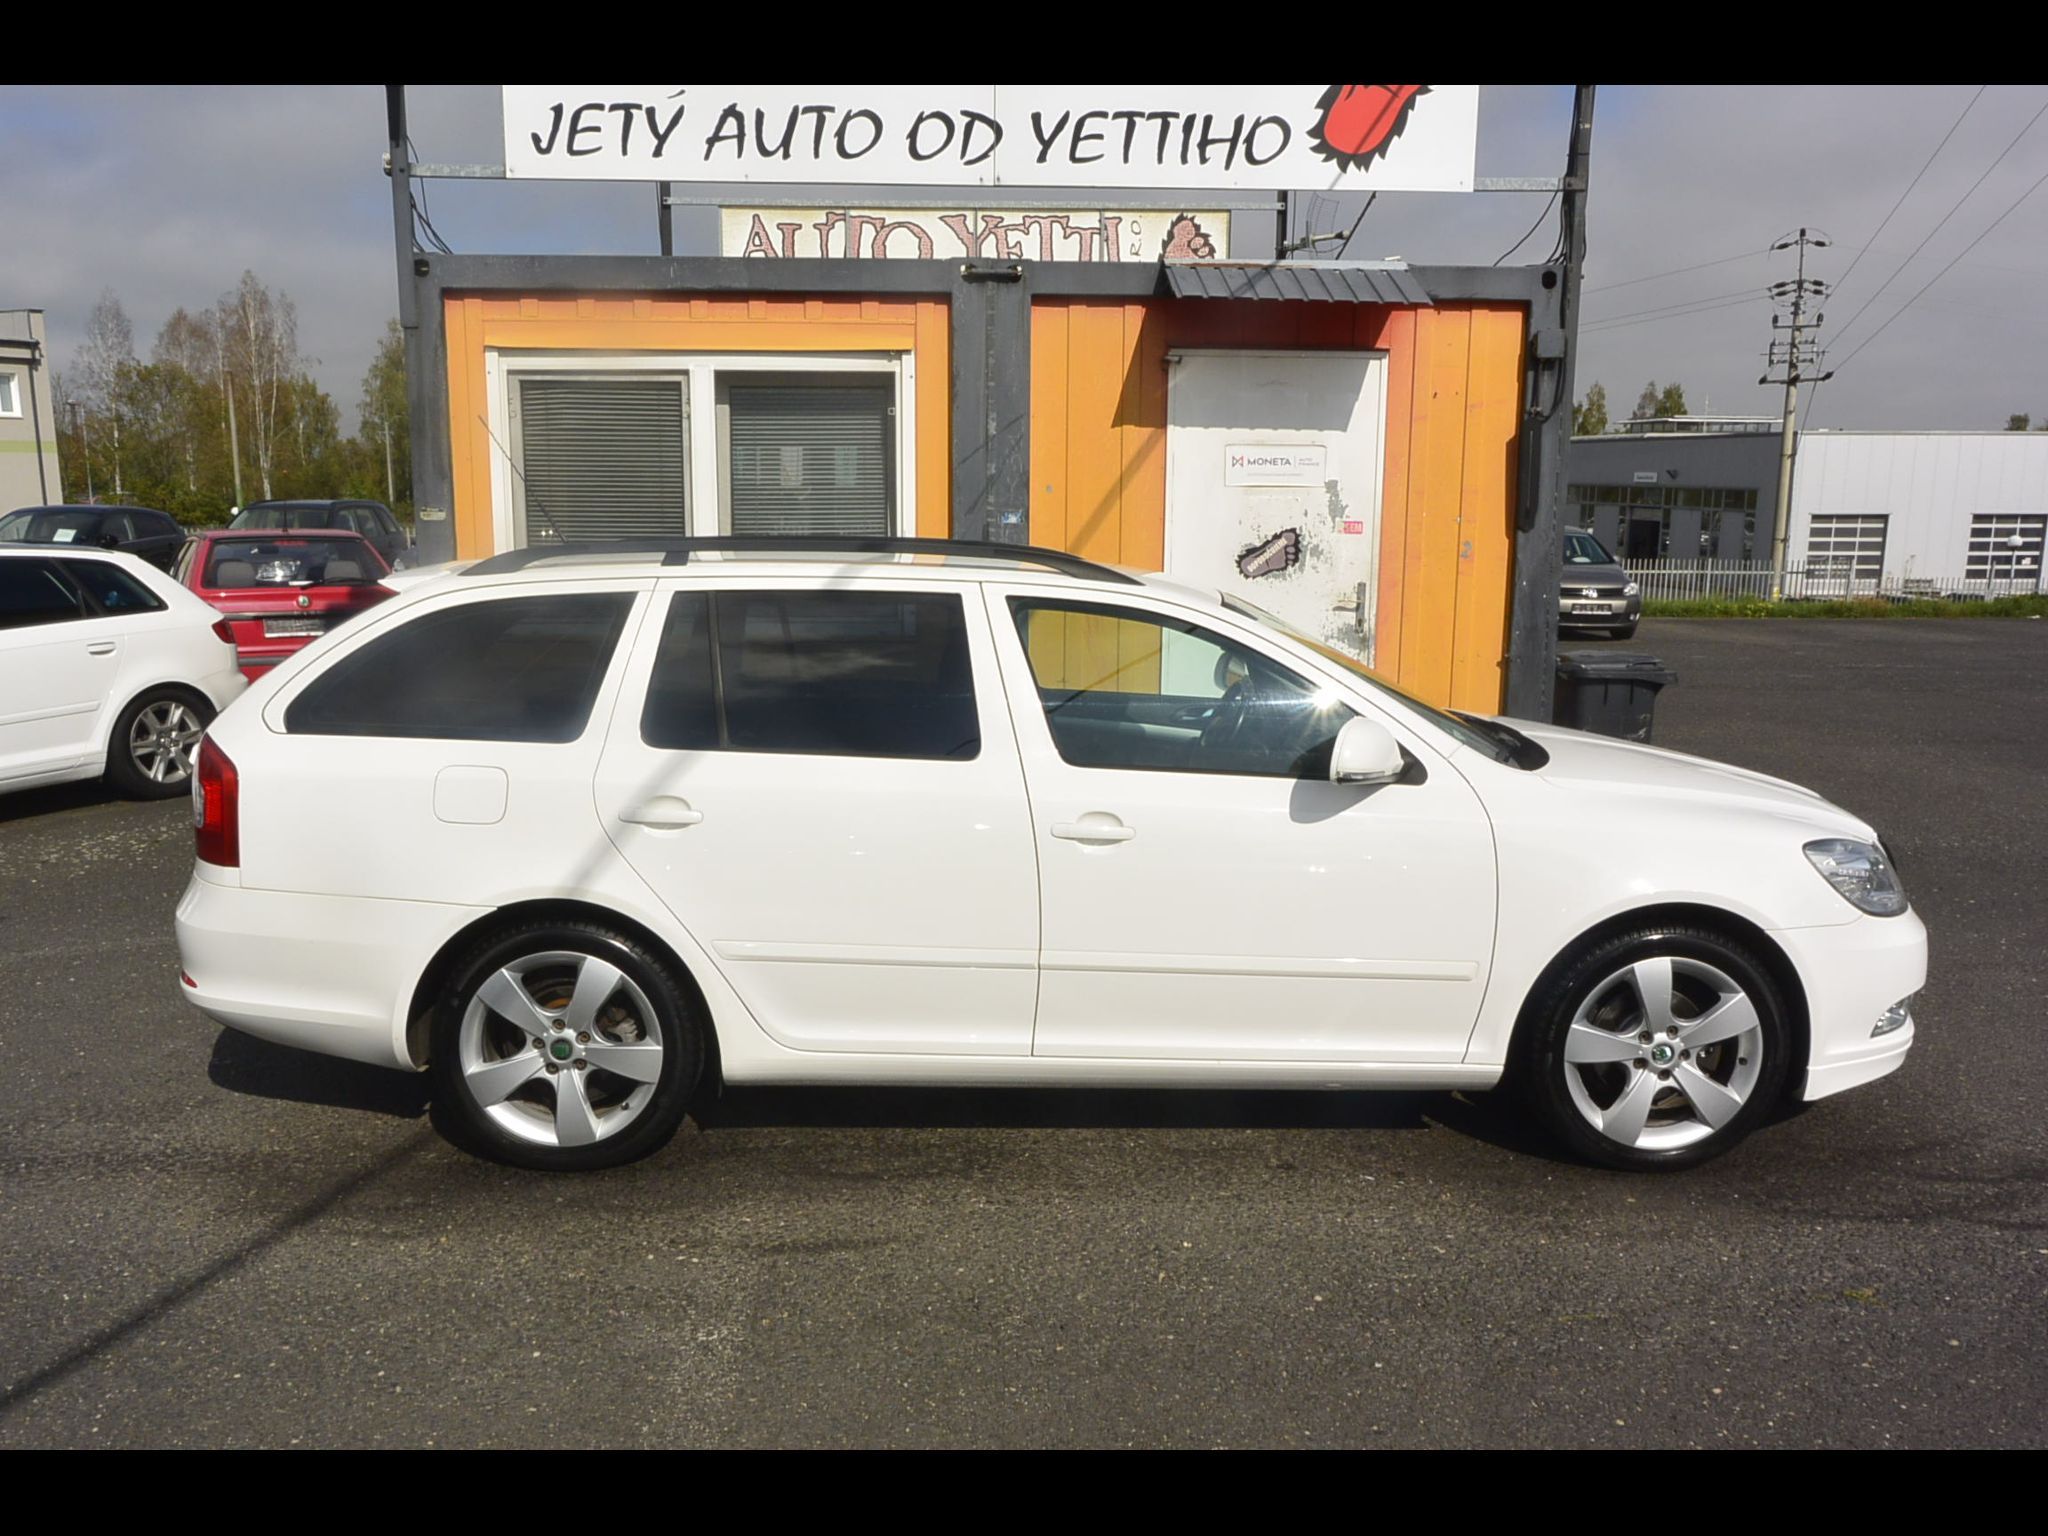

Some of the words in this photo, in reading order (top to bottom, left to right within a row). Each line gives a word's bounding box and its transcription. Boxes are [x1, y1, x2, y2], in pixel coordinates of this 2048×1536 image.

[531, 89, 685, 158] JETÝ
[704, 103, 884, 161] AUTO
[906, 110, 1003, 166] OD
[1030, 110, 1292, 171] YETTIHO
[1247, 457, 1292, 466] MONETA
